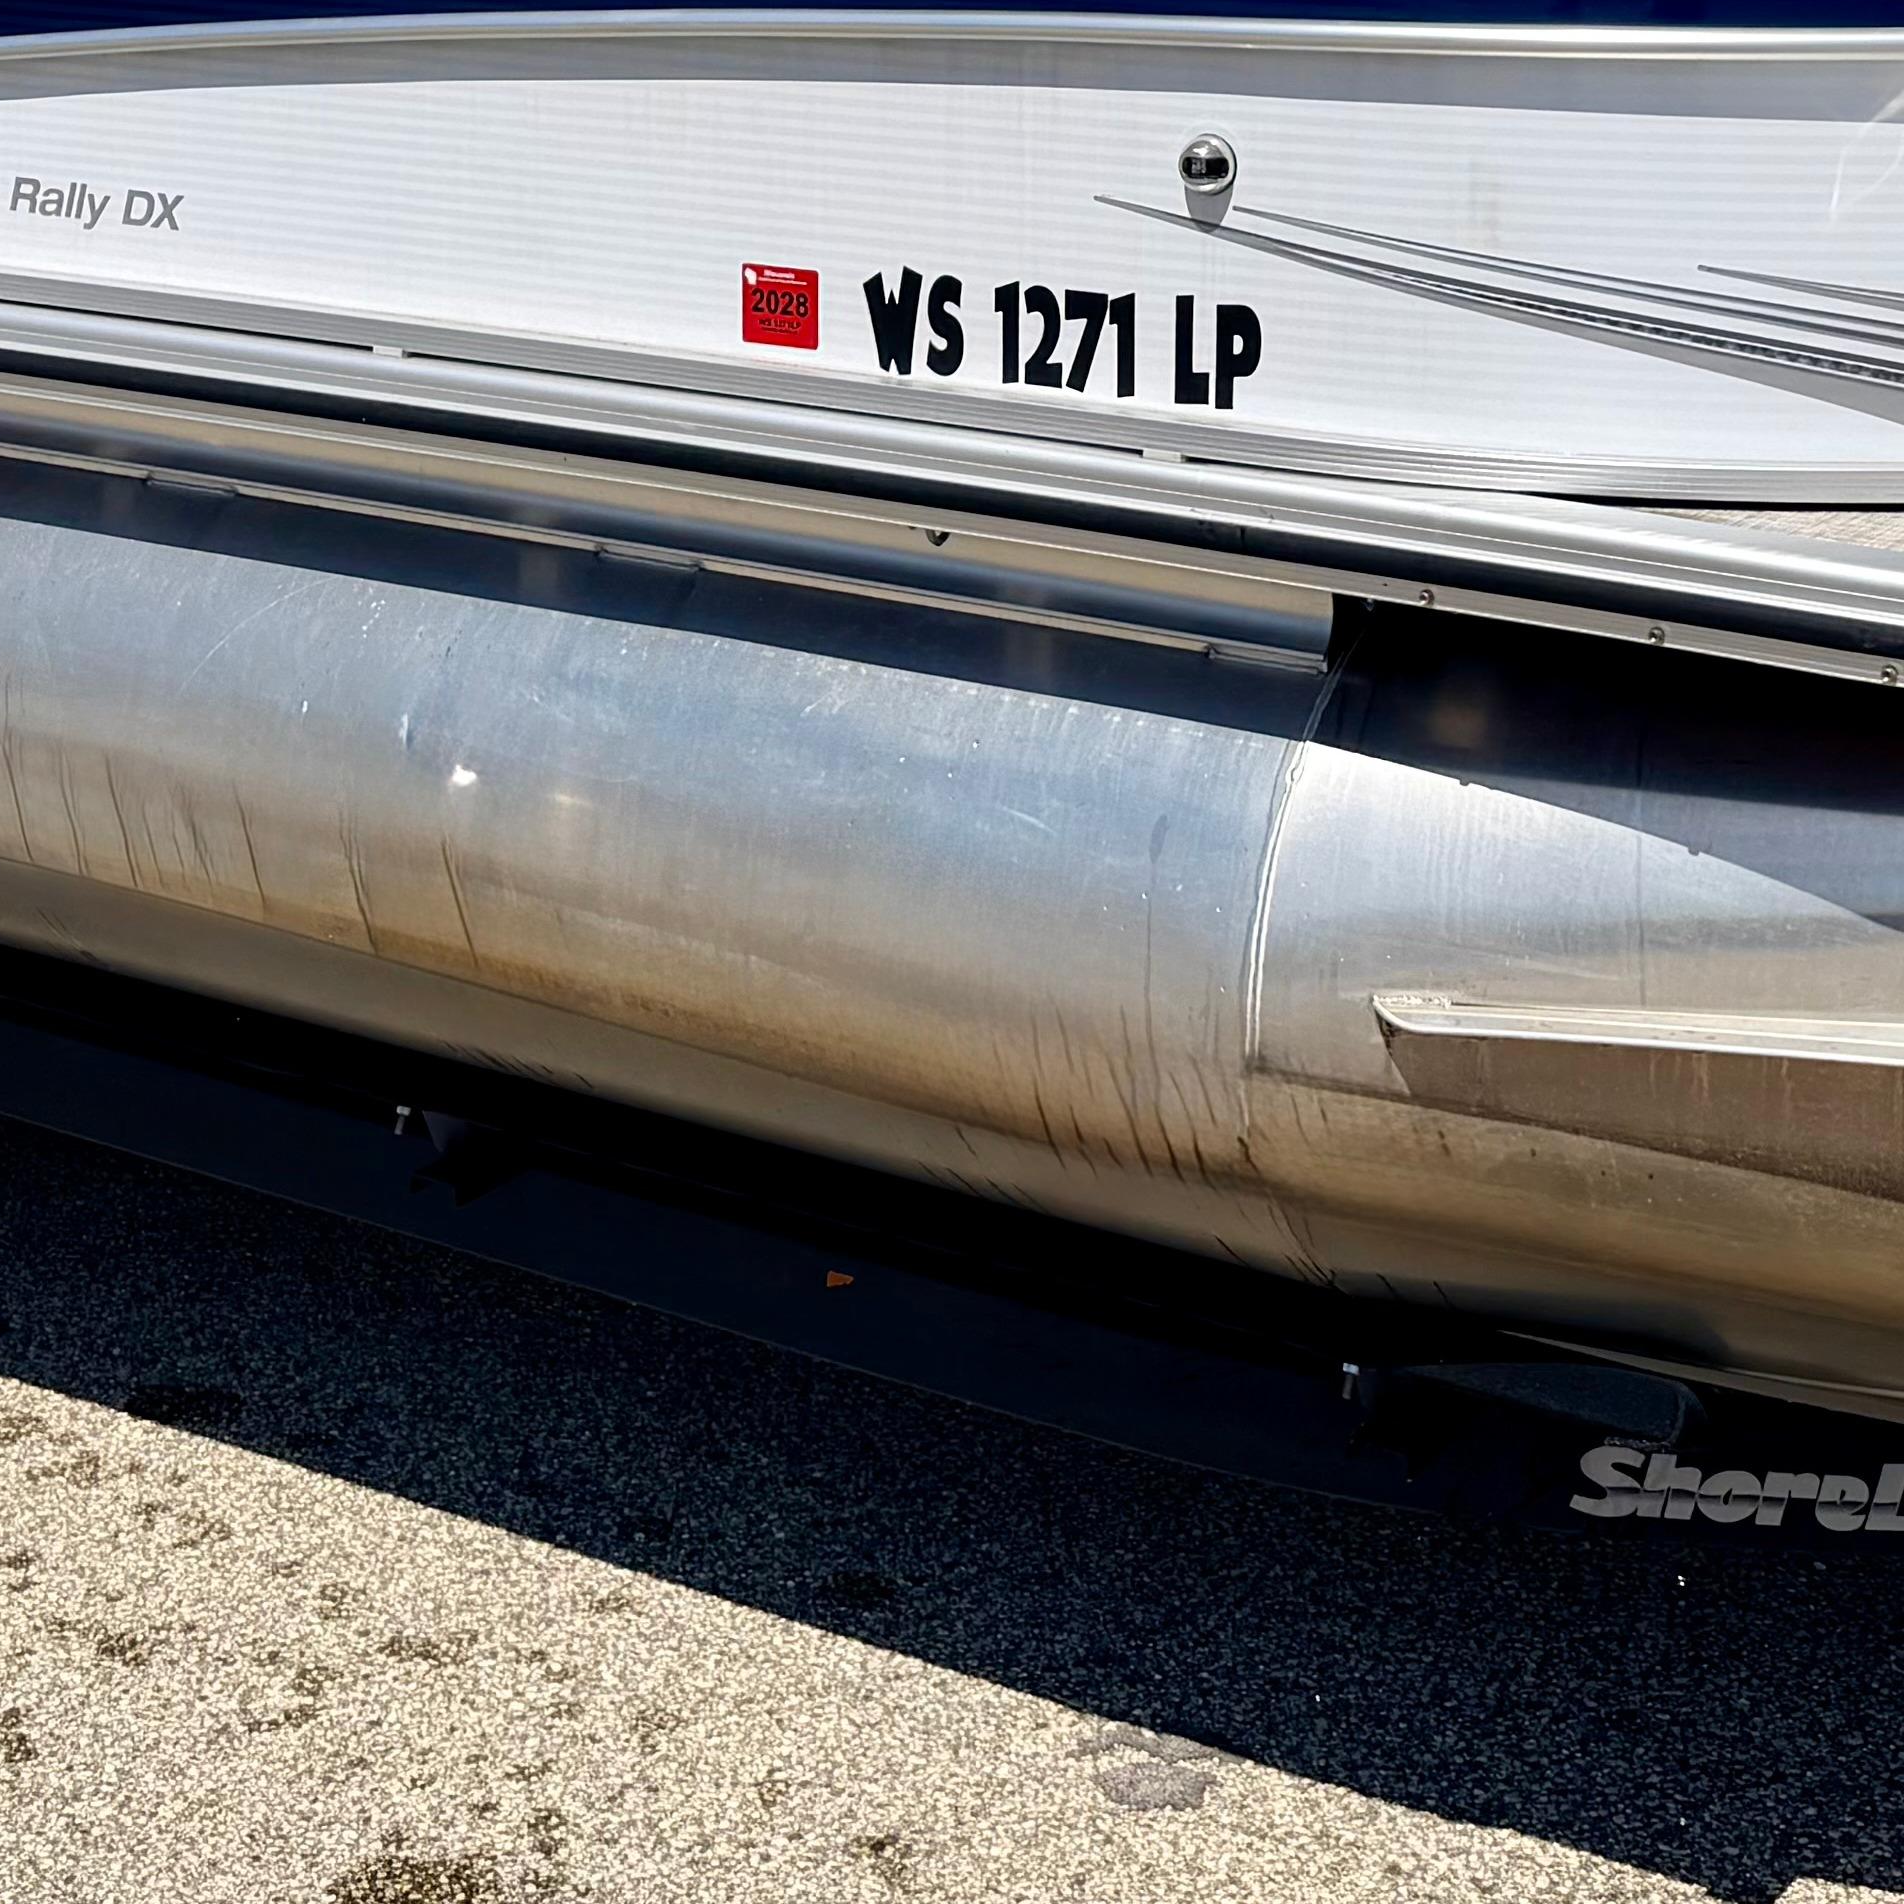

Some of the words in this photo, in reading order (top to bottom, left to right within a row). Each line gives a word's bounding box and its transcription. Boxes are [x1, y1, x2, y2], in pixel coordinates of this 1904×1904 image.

[9, 176, 111, 230] Rally
[122, 188, 185, 231] DX
[751, 287, 809, 318] 2028
[863, 265, 964, 376] WS
[994, 280, 1136, 398] 1271
[1174, 294, 1262, 410] LP
